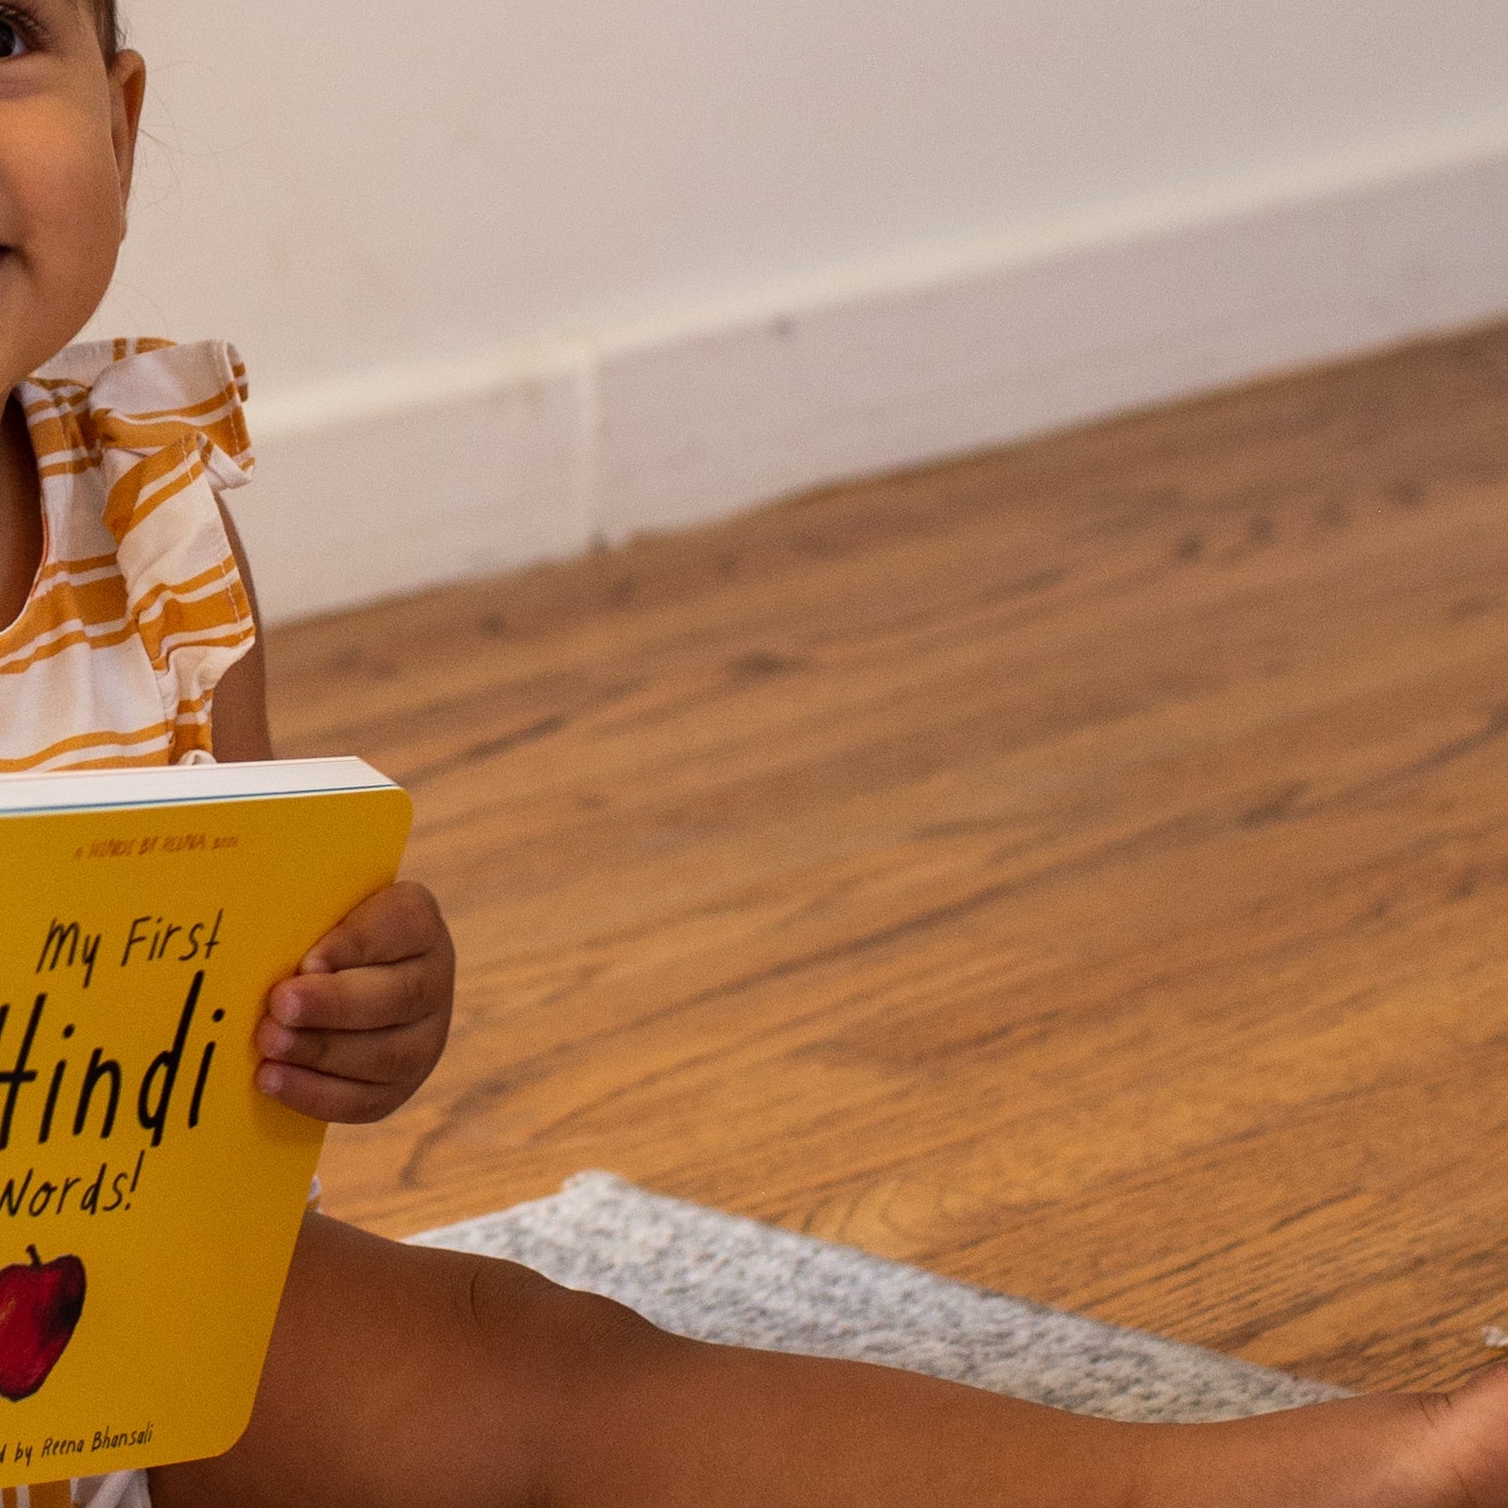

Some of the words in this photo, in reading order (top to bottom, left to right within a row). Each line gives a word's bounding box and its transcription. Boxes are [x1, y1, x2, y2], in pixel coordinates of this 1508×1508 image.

[36, 917, 102, 988] My
[120, 908, 224, 963] First
[14, 1441, 33, 1467] by
[40, 1437, 85, 1458] Reena
[91, 1421, 154, 1452] Bhansali
